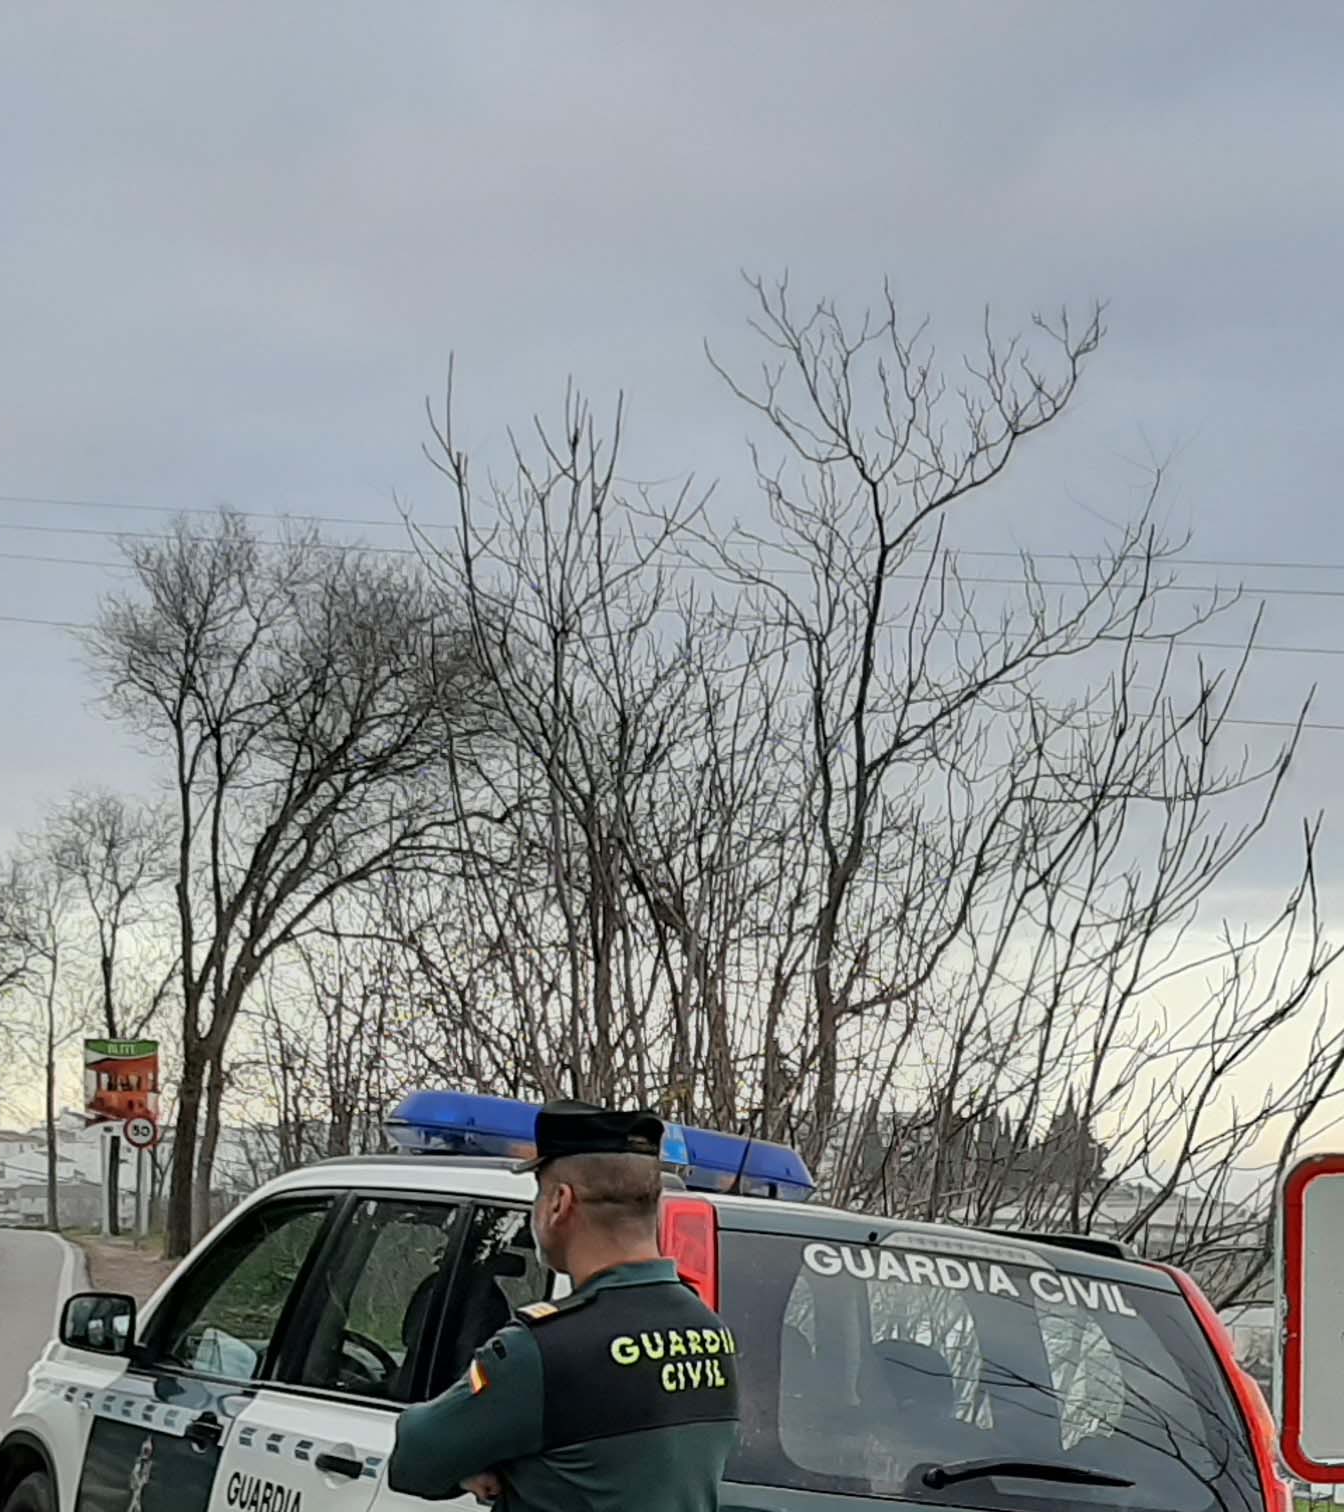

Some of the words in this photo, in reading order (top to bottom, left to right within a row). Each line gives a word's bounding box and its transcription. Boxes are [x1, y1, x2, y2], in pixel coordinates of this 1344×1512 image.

[132, 1124, 151, 1137] 50
[803, 1242, 1020, 1298] GUARDIA
[1029, 1270, 1138, 1318] CIVIL
[661, 1358, 726, 1392] CIVIL
